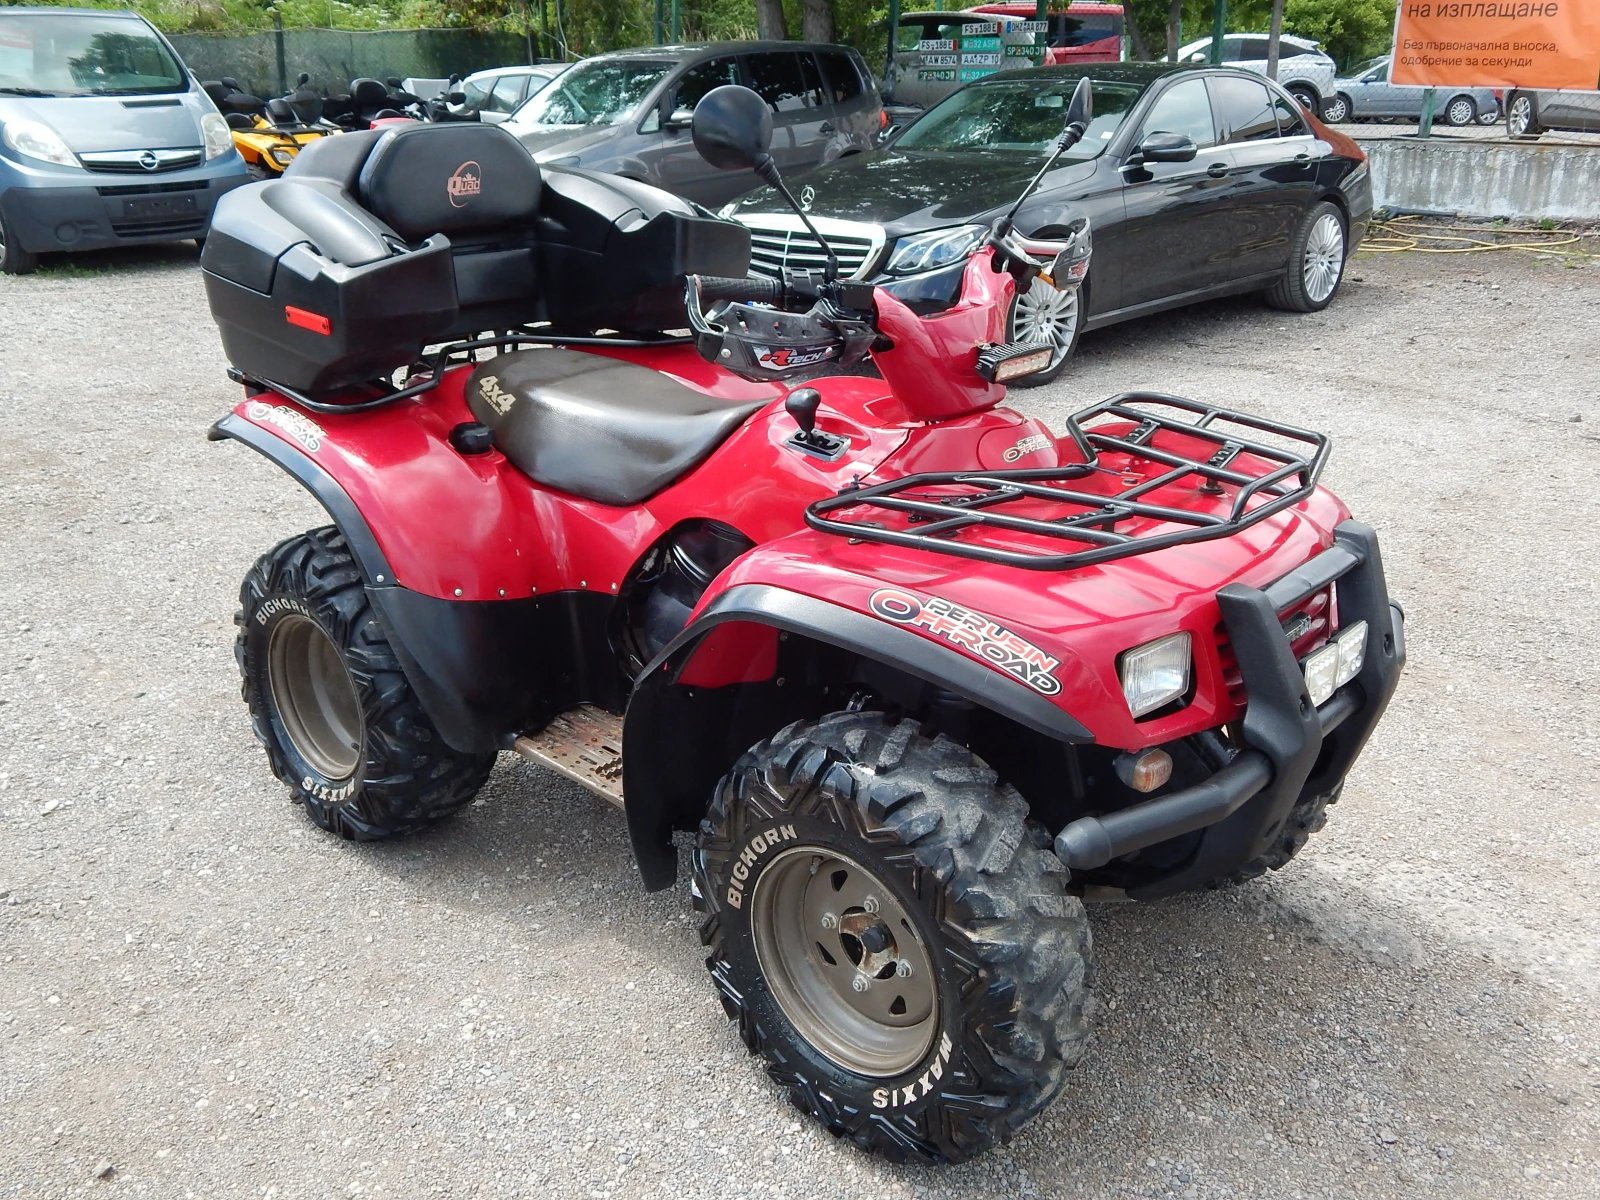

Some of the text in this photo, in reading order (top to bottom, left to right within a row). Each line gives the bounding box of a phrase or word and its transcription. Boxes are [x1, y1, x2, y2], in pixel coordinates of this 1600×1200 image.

[1408, 1, 1558, 20] на изплащане
[964, 25, 974, 34] FS
[1026, 22, 1035, 31] AA
[1036, 22, 1047, 31] 877
[921, 41, 931, 49] FS
[936, 40, 947, 49] 188
[973, 39, 982, 48] 32
[1007, 46, 1015, 55] SP
[1021, 46, 1035, 55] 340
[1403, 38, 1559, 53] Без първоначална вноска,
[928, 55, 940, 64] AW
[940, 55, 956, 64] 8574
[964, 54, 974, 63] AA
[978, 54, 989, 63] ZP
[1401, 56, 1532, 67] одобрение за секунди
[447, 177, 480, 195] Quad
[255, 598, 310, 626] BIGHORN
[870, 588, 1061, 694] OFFROAD
[927, 597, 1059, 671] PERUSIN
[301, 776, 356, 802] MAXXIS
[727, 824, 798, 909] BIGHORN
[872, 1031, 953, 1109] MAXXIS
